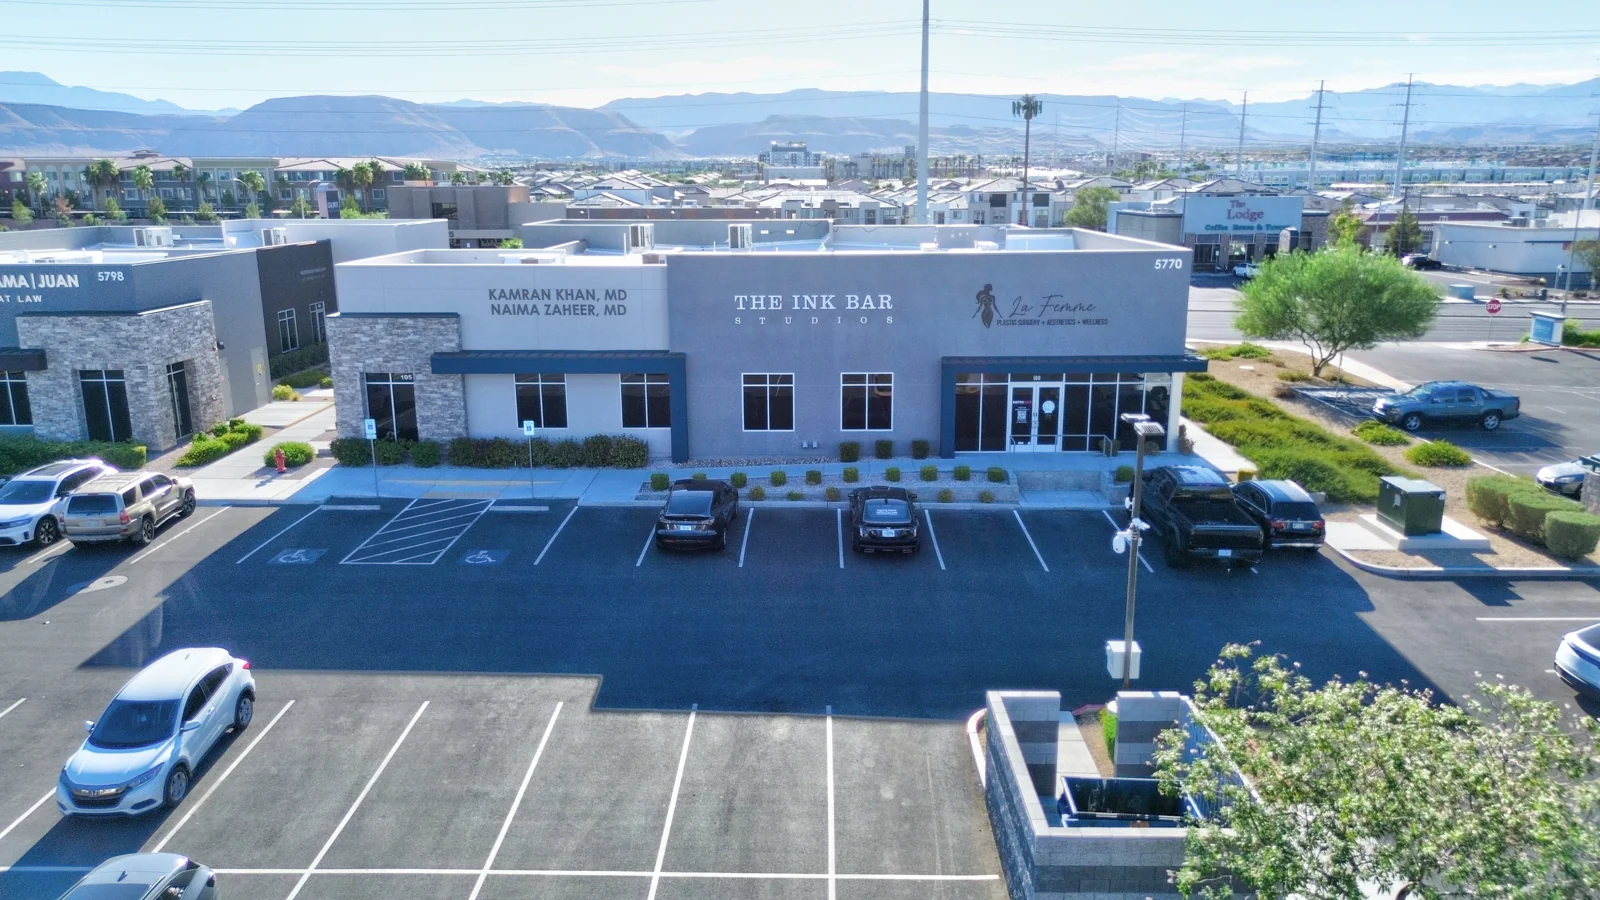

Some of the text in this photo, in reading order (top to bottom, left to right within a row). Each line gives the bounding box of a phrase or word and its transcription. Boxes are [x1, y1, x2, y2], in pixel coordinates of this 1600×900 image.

[1229, 199, 1246, 208] The
[1227, 208, 1264, 222] Lodge
[1154, 258, 1182, 270] 5770
[97, 271, 125, 282] 5798
[17, 295, 42, 303] LAW
[488, 288, 628, 303] KAMRAN KHAN, MD
[734, 294, 893, 310] THE INK BAR
[1009, 294, 1097, 318] La Femme
[490, 304, 627, 317] NAIMA ZAHEER, MD
[734, 316, 893, 325] STUDIOS
[996, 319, 1016, 327] PLASTIC
[1046, 318, 1076, 326] AESTHETICS
[1082, 318, 1108, 326] WELLNESS
